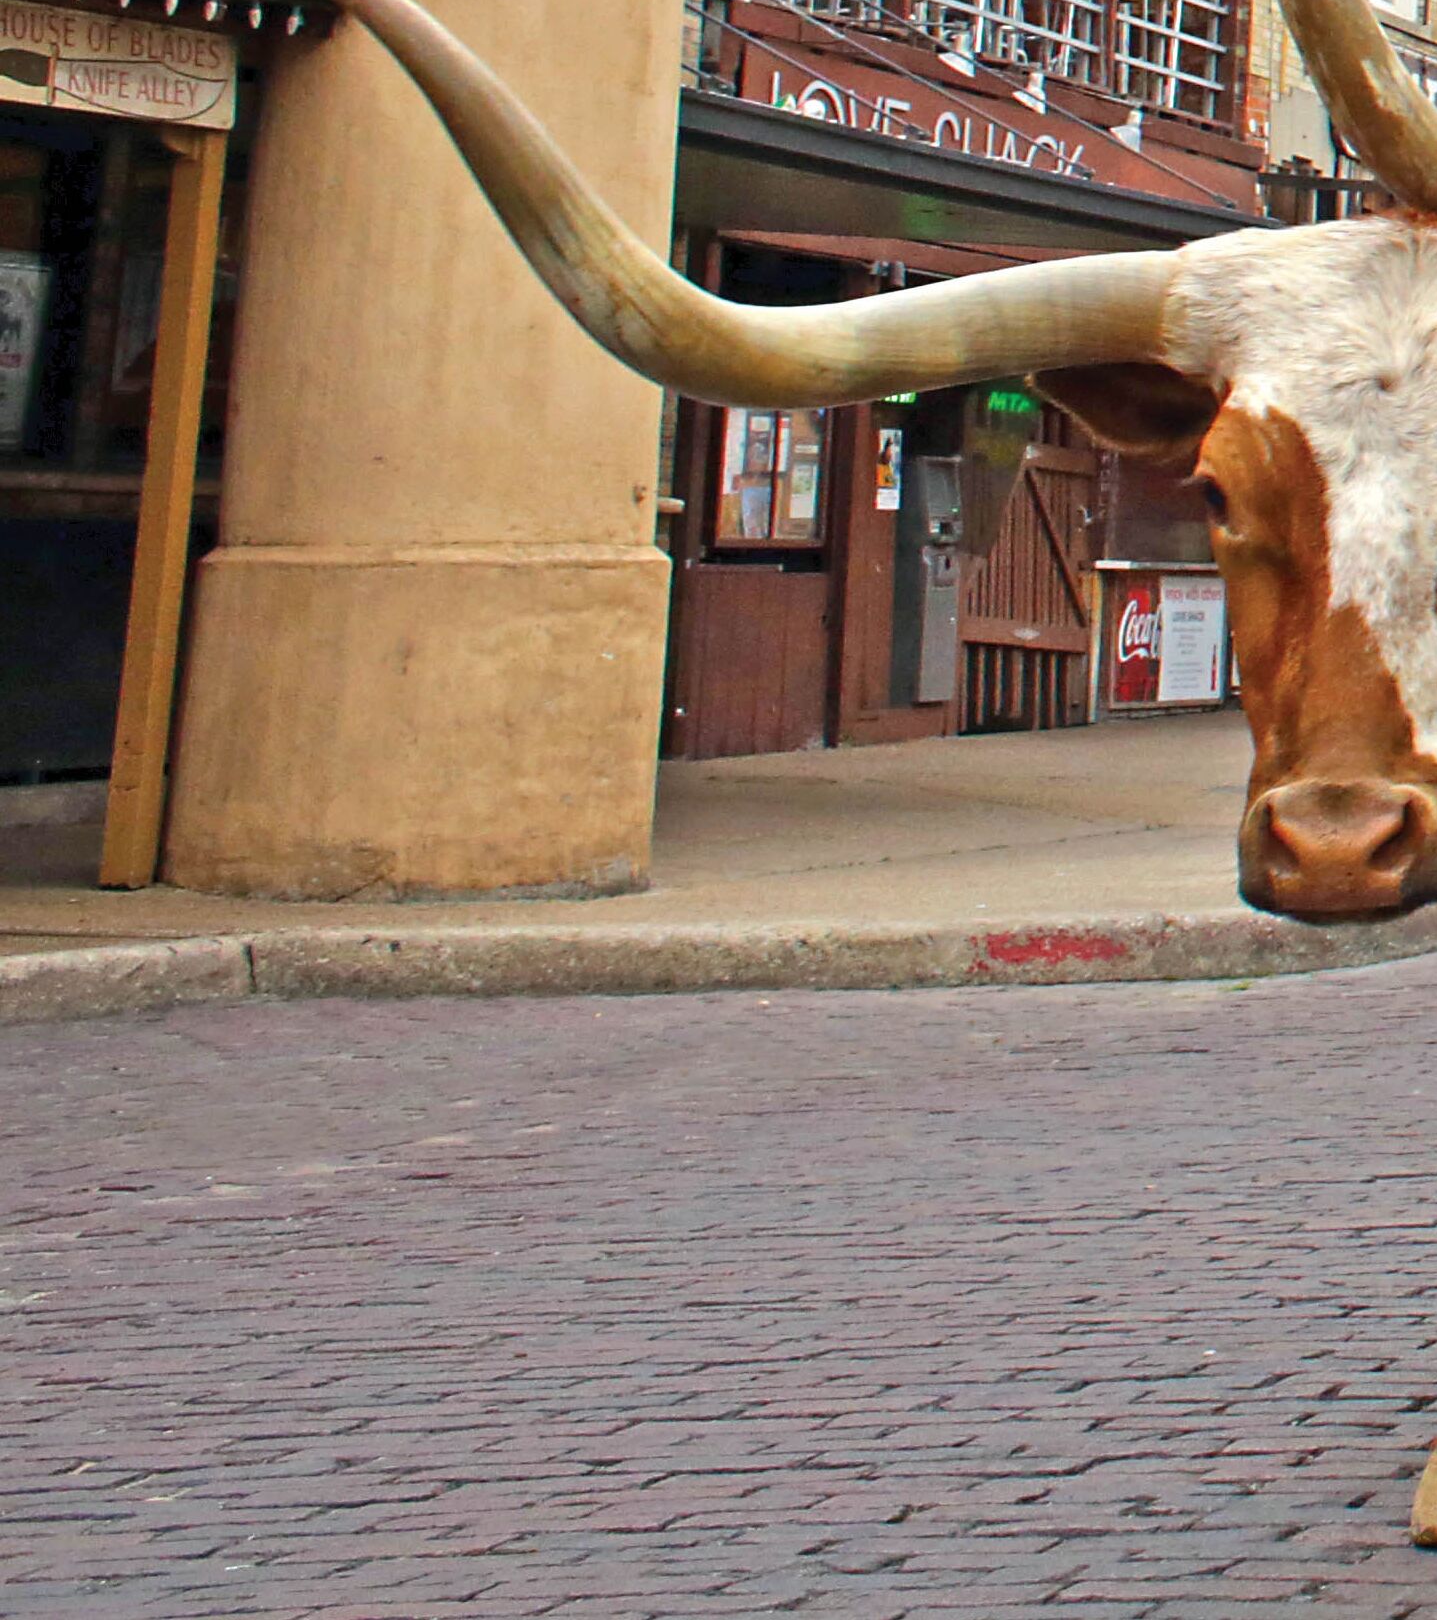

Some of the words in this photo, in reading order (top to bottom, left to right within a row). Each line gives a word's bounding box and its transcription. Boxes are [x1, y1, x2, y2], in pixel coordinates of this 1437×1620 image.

[87, 21, 118, 53] OF
[130, 30, 221, 70] BLADES
[68, 62, 129, 100] KNIFE
[136, 74, 199, 108] ALLEY
